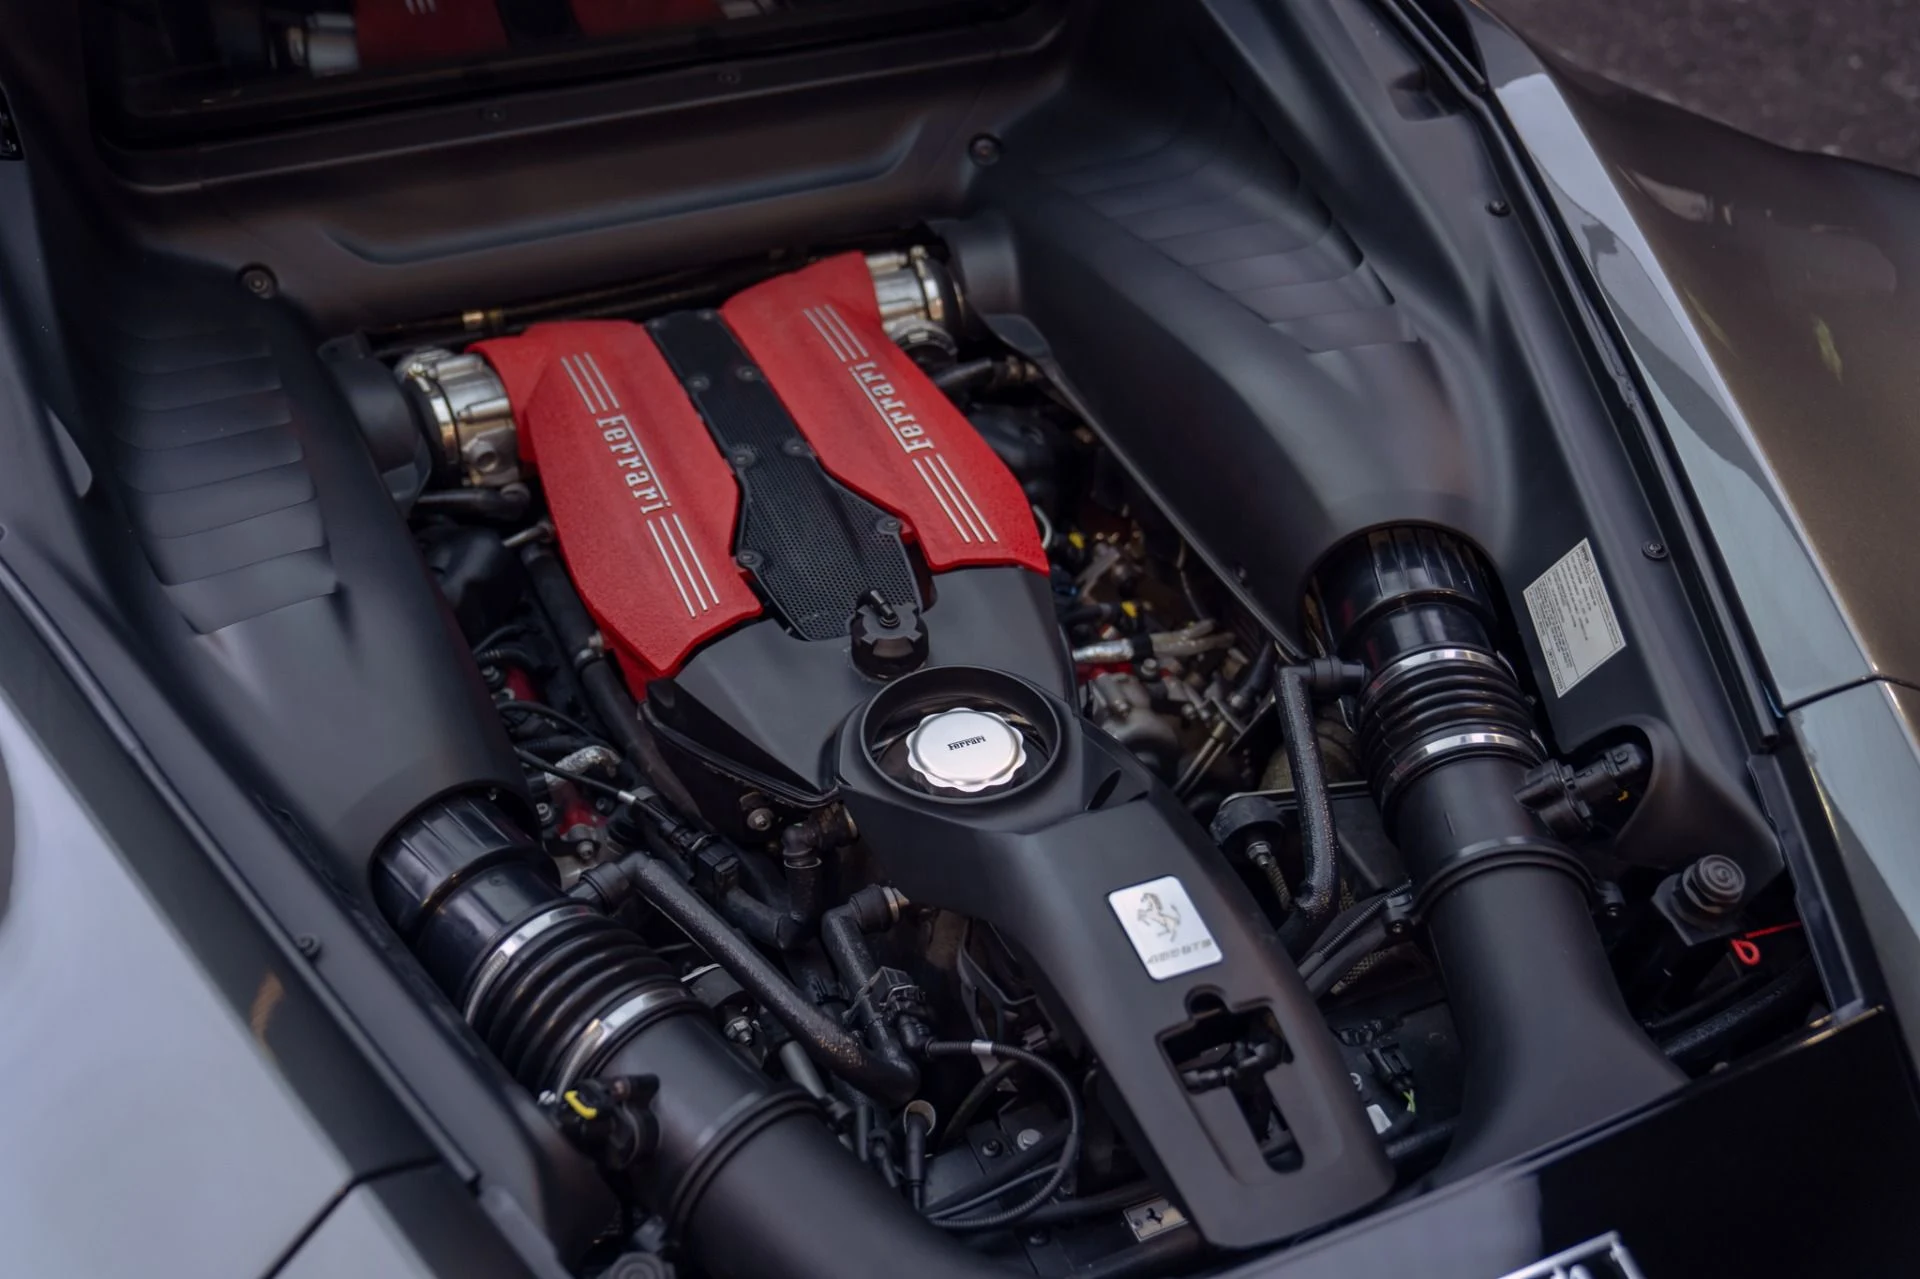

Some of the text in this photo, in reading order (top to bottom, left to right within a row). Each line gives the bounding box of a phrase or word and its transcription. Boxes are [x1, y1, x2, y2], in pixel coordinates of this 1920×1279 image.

[848, 362, 934, 453] Ferrari
[596, 414, 672, 514] Ferrari
[947, 735, 986, 751] Ferrari
